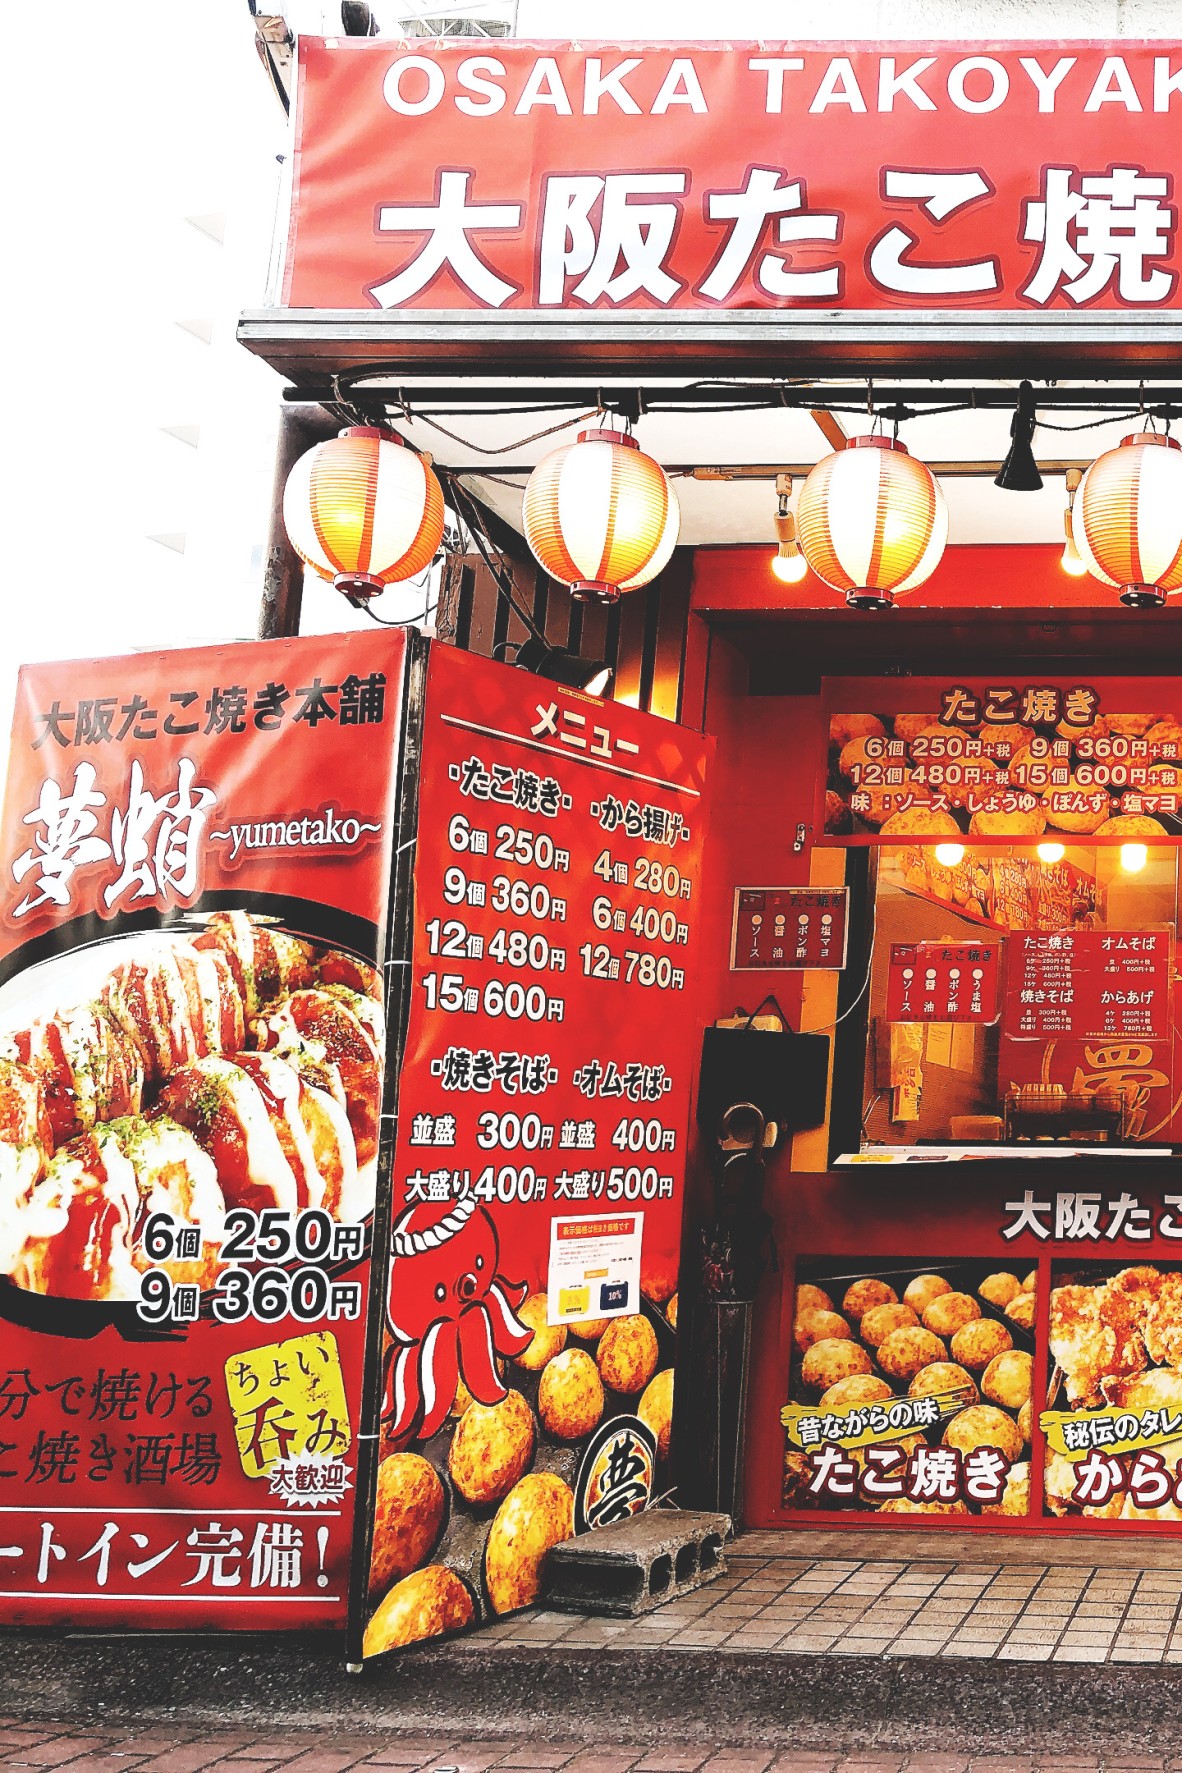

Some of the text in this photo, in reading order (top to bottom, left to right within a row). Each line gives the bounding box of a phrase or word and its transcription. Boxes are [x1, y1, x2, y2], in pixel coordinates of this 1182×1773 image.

[381, 56, 709, 116] OSAKA
[31, 672, 388, 750] 大阪たこ焼き本舗
[943, 688, 1097, 723] たこ焼き
[530, 702, 640, 758] メニュー
[866, 737, 904, 758] 6個
[1031, 737, 1069, 758] 9個
[850, 765, 903, 785] 12個
[1016, 765, 1068, 785] 15個
[449, 815, 570, 872] 6個 250円
[443, 867, 567, 921] 9個 360円
[593, 850, 692, 900] 4個 280円
[592, 896, 689, 944] 6個 400円
[749, 926, 761, 958] ソース
[820, 925, 832, 957] 塩マヨ
[1023, 935, 1075, 950] たこ焼き
[1101, 936, 1157, 951] オムそば
[426, 919, 566, 971] 12個 480円
[580, 943, 685, 990] 12個 780円
[942, 949, 992, 962] たこ焼き
[422, 972, 564, 1022] 15個 600円
[901, 980, 913, 1011] ソース
[970, 980, 982, 1012] うま塩
[1020, 989, 1075, 1004] 焼きそば
[1101, 990, 1155, 1004] からあげ
[409, 1112, 554, 1150] 並盛 300円
[559, 1118, 676, 1152] 並盛 400円
[144, 1209, 363, 1263] 6個 250円
[138, 1268, 361, 1322] 9個 360円
[234, 1346, 330, 1397] ちょい
[238, 1397, 347, 1470] 呑み
[797, 1396, 941, 1446] 昔ながらの味
[271, 1463, 344, 1491] 大歓迎
[809, 1446, 1008, 1500] たこ焼き
